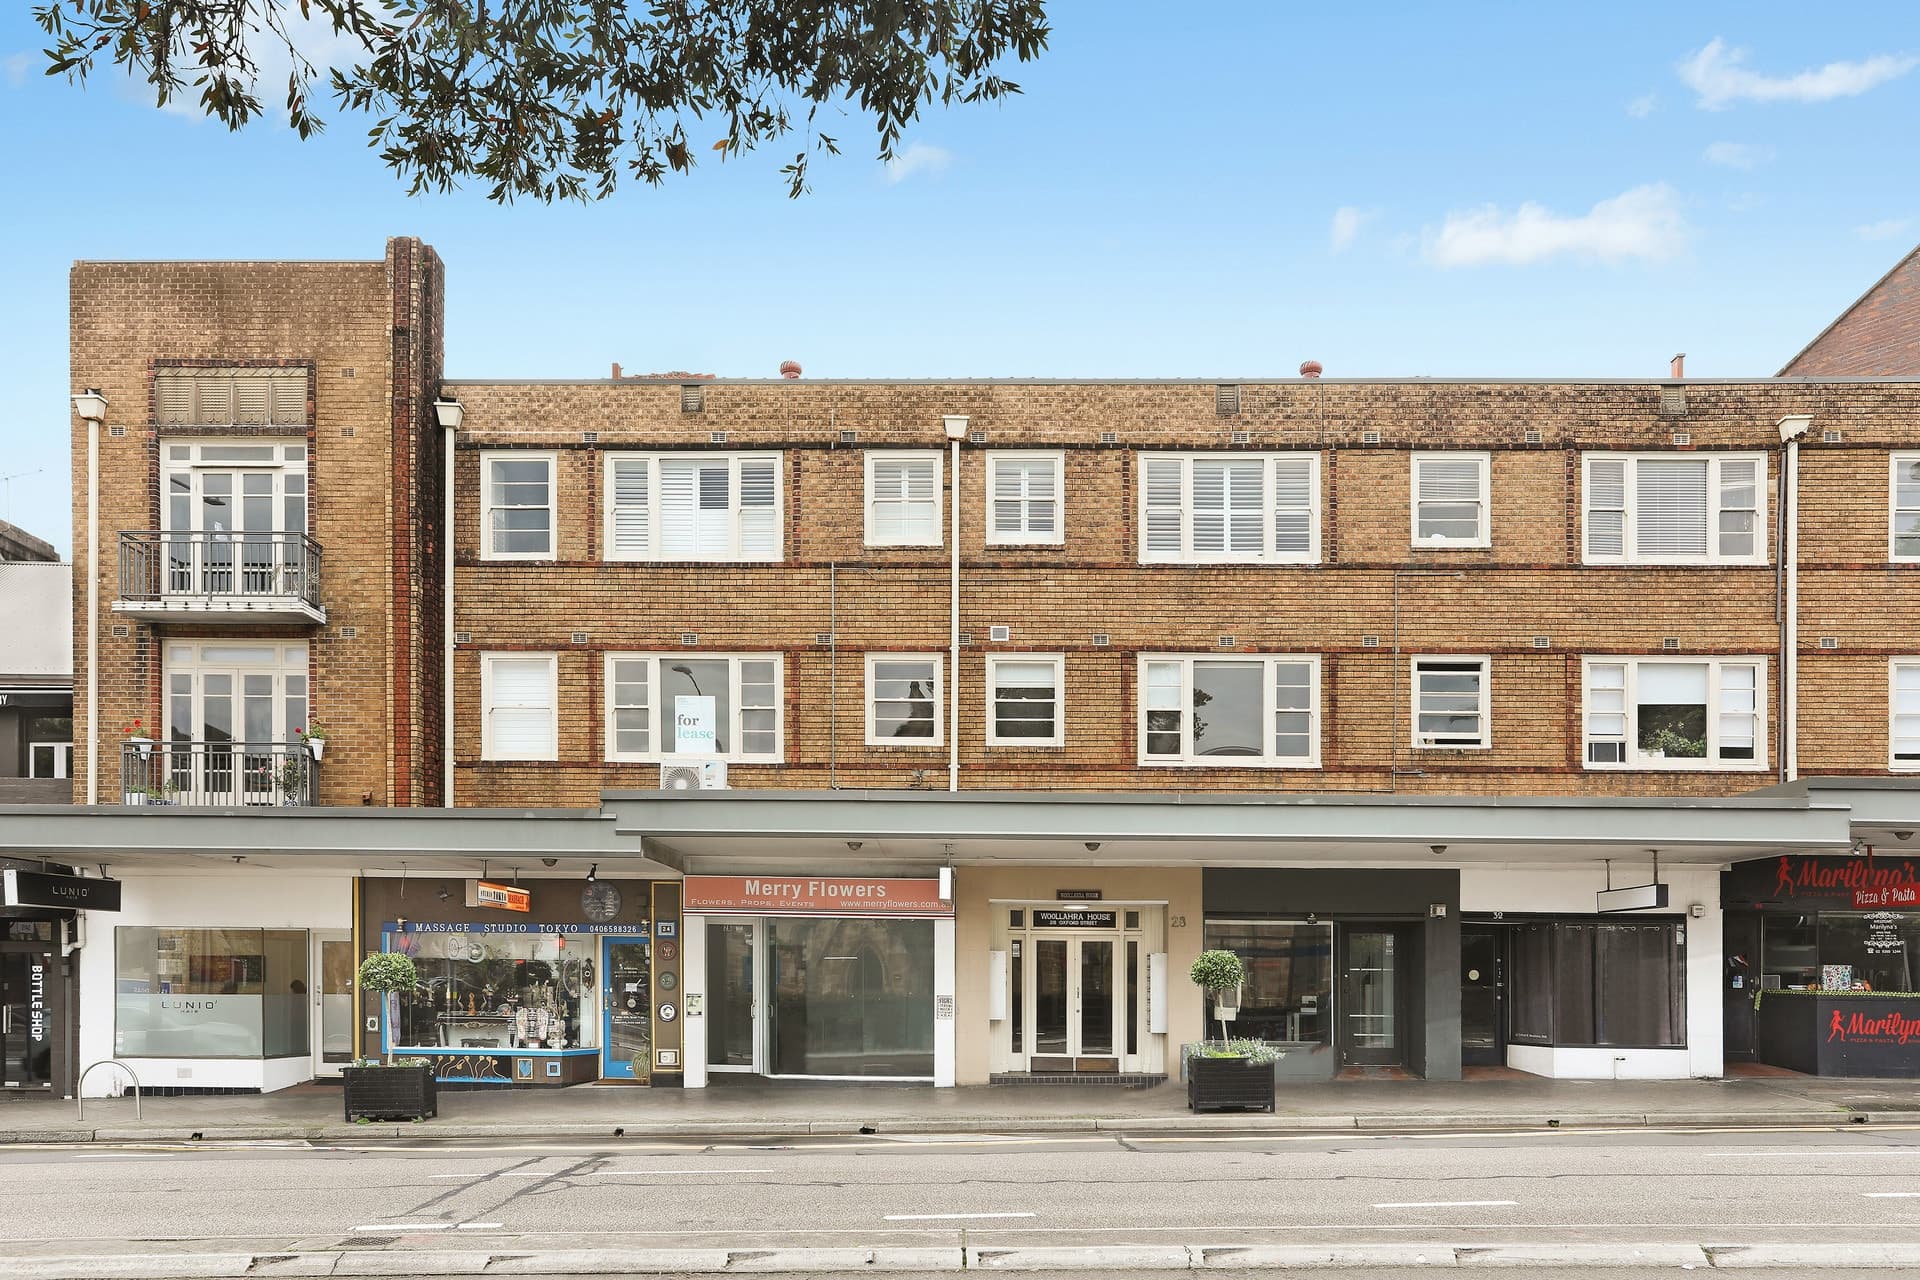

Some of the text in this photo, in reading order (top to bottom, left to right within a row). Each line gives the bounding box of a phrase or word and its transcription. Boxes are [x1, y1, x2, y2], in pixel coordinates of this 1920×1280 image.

[677, 714, 699, 726] for
[677, 727, 714, 739] lease
[745, 880, 886, 899] Merry Flowers
[1856, 887, 1916, 905] Pizza & Pasta
[840, 900, 950, 909] www.merryflowers.com.a
[1040, 912, 1111, 921] WOOLLAHRA HOUSE
[1493, 911, 1504, 920] 32
[415, 923, 637, 933] MASSAGE STUDIO TOKYO 0406588326
[1171, 916, 1186, 928] 28
[1846, 1012, 1920, 1045] Marilyn
